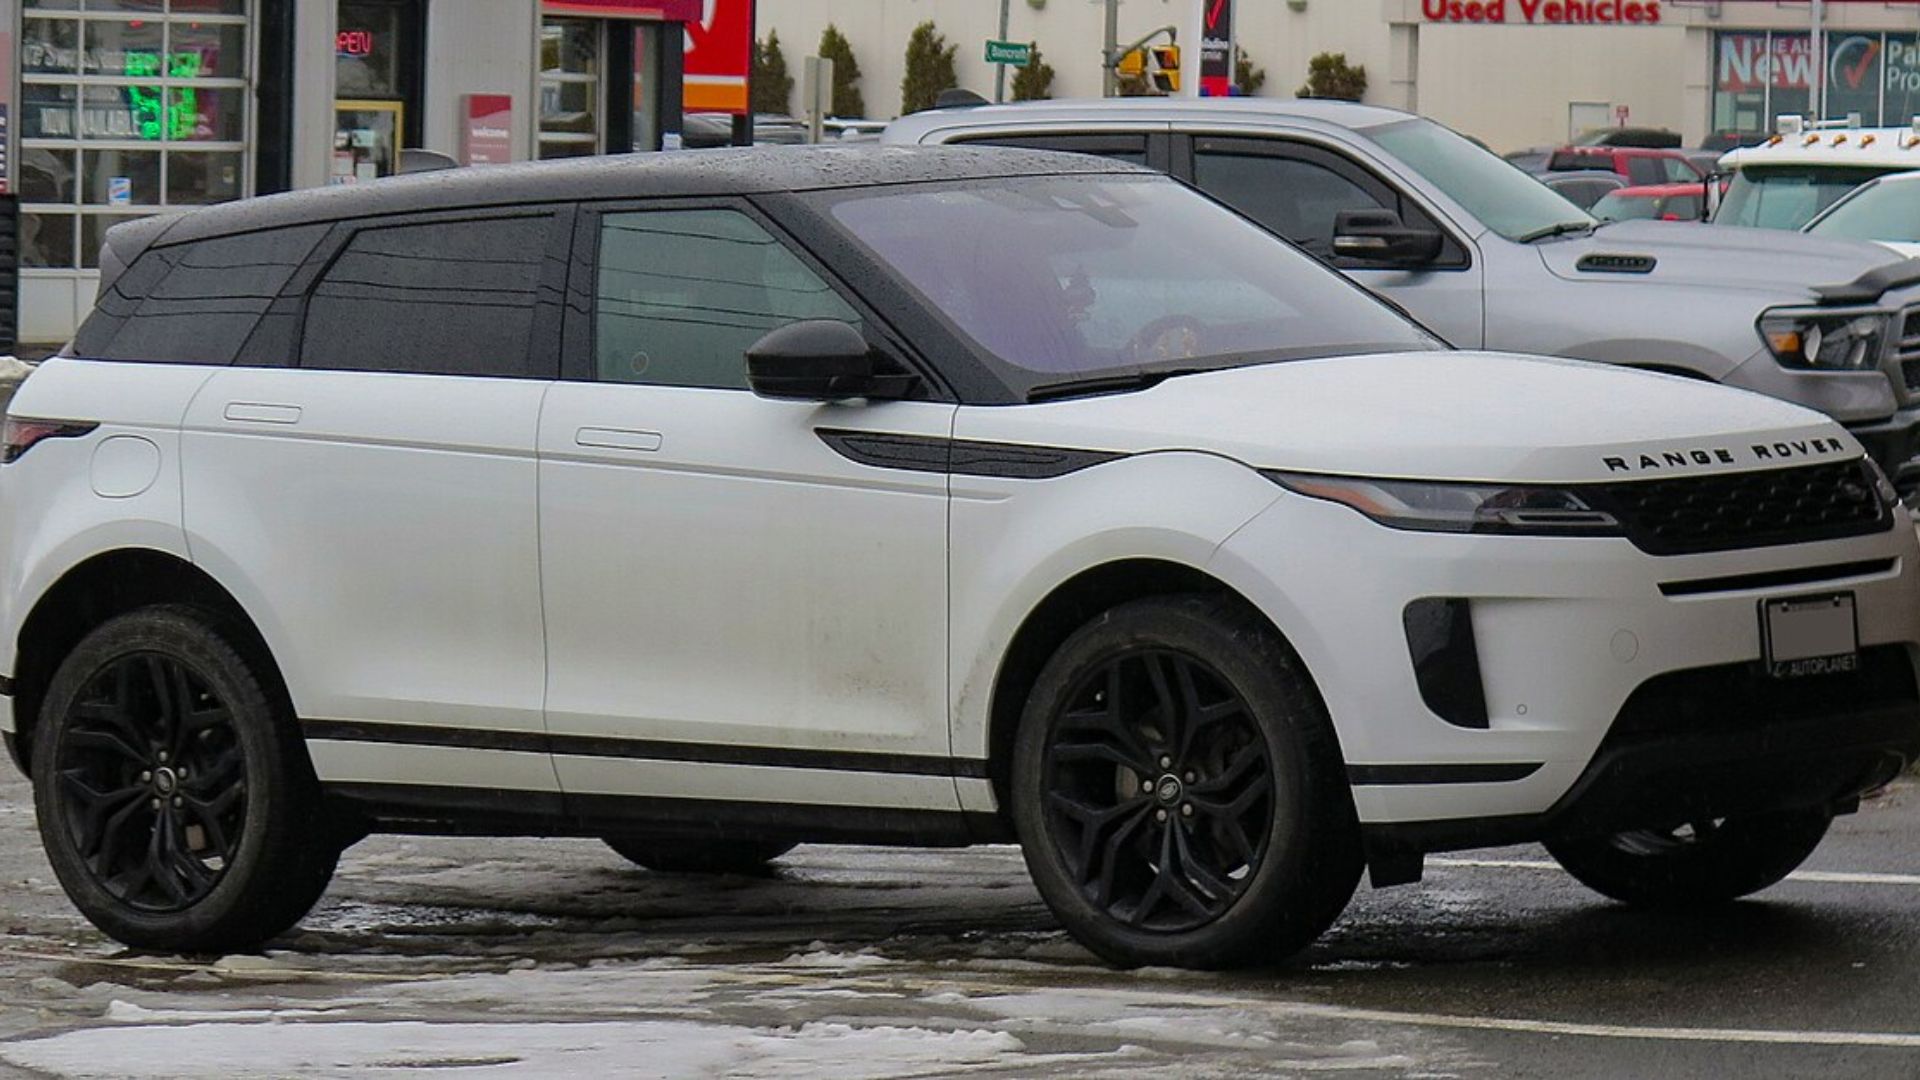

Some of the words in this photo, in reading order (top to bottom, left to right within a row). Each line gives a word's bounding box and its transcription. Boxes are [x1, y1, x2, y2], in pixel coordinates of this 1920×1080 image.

[1421, 0, 1505, 22] Used
[1518, 0, 1660, 22] Vehicles
[336, 31, 371, 53] PEN
[1720, 37, 1816, 84] New
[1603, 448, 1735, 472] RANGE
[1751, 437, 1845, 459] ROVER
